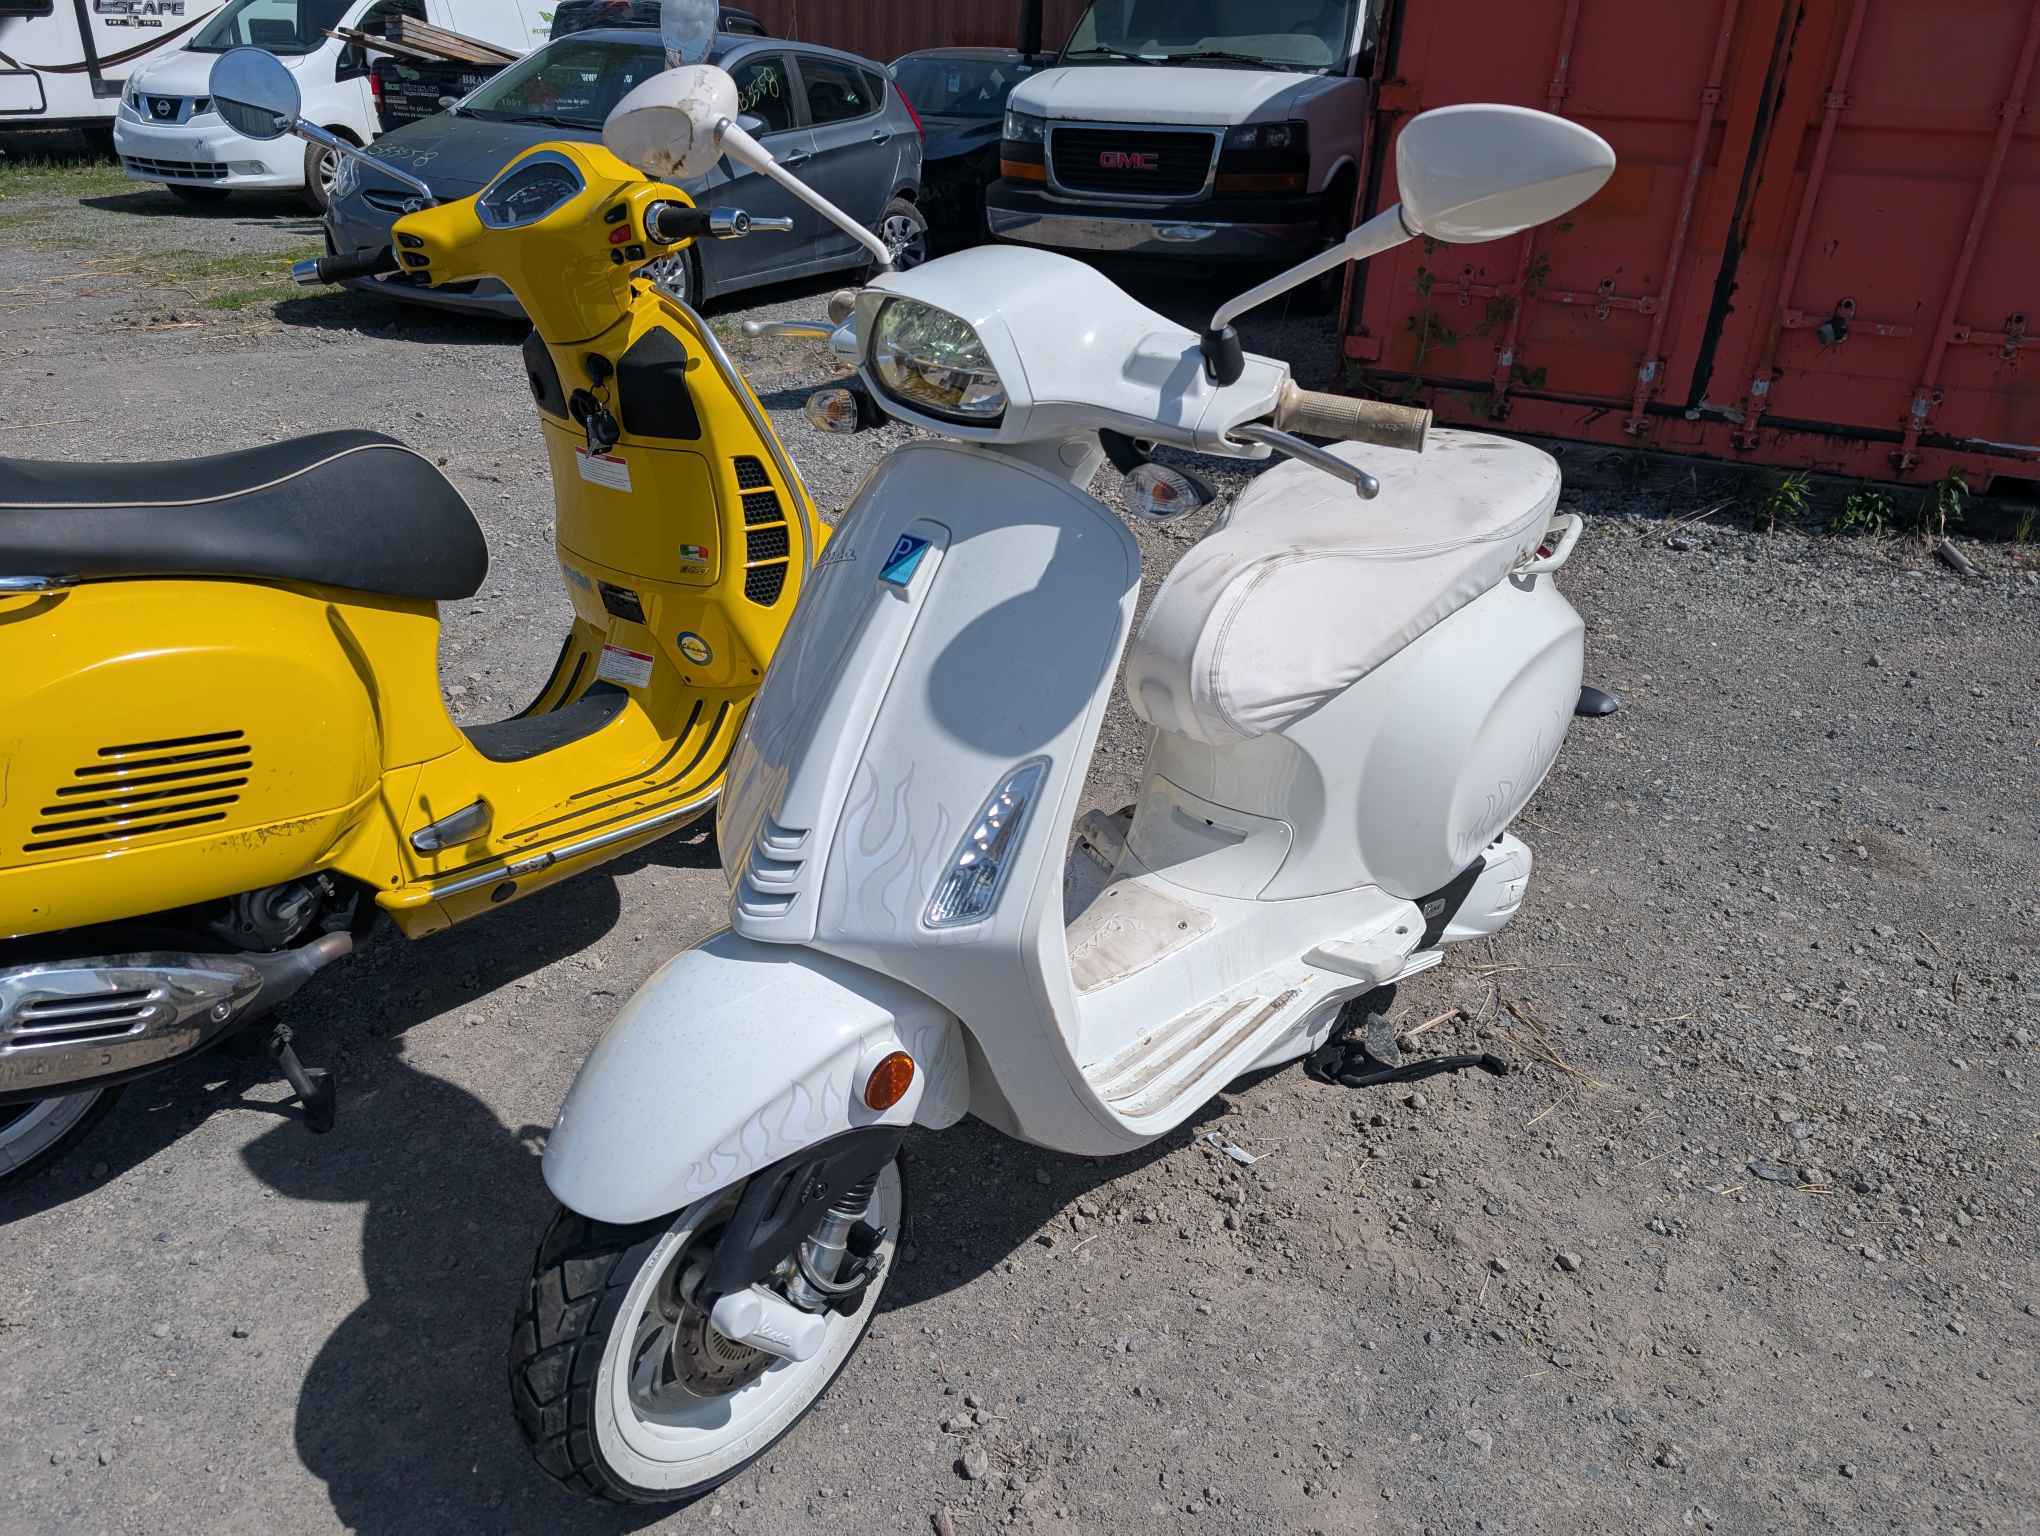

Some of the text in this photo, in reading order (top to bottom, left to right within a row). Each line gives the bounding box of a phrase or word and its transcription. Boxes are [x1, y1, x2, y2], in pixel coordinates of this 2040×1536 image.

[93, 0, 184, 16] ESCAPE
[1099, 151, 1159, 169] GMC
[888, 537, 913, 563] P
